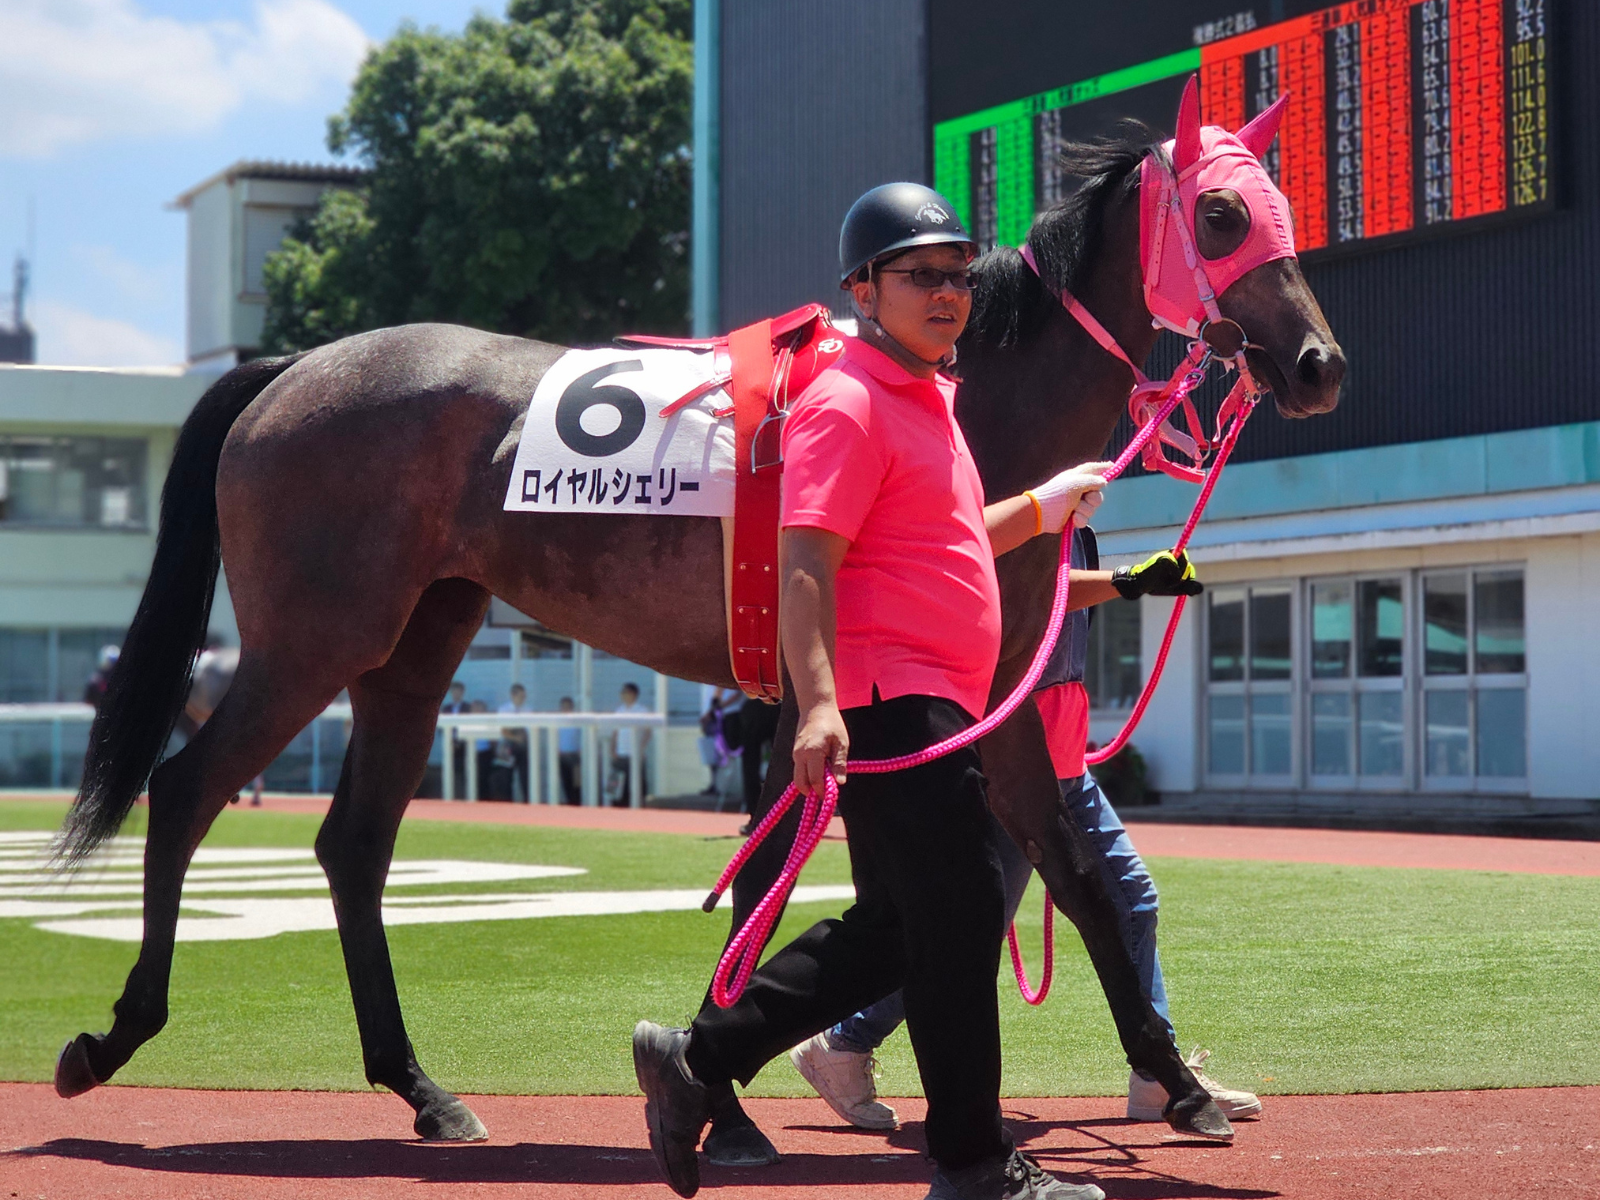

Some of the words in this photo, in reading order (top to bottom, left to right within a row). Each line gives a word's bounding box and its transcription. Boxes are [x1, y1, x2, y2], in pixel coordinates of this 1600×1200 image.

[1511, 38, 1545, 67] 101.0
[556, 359, 646, 457] 6
[521, 467, 699, 507] ロイヤルシェリー
